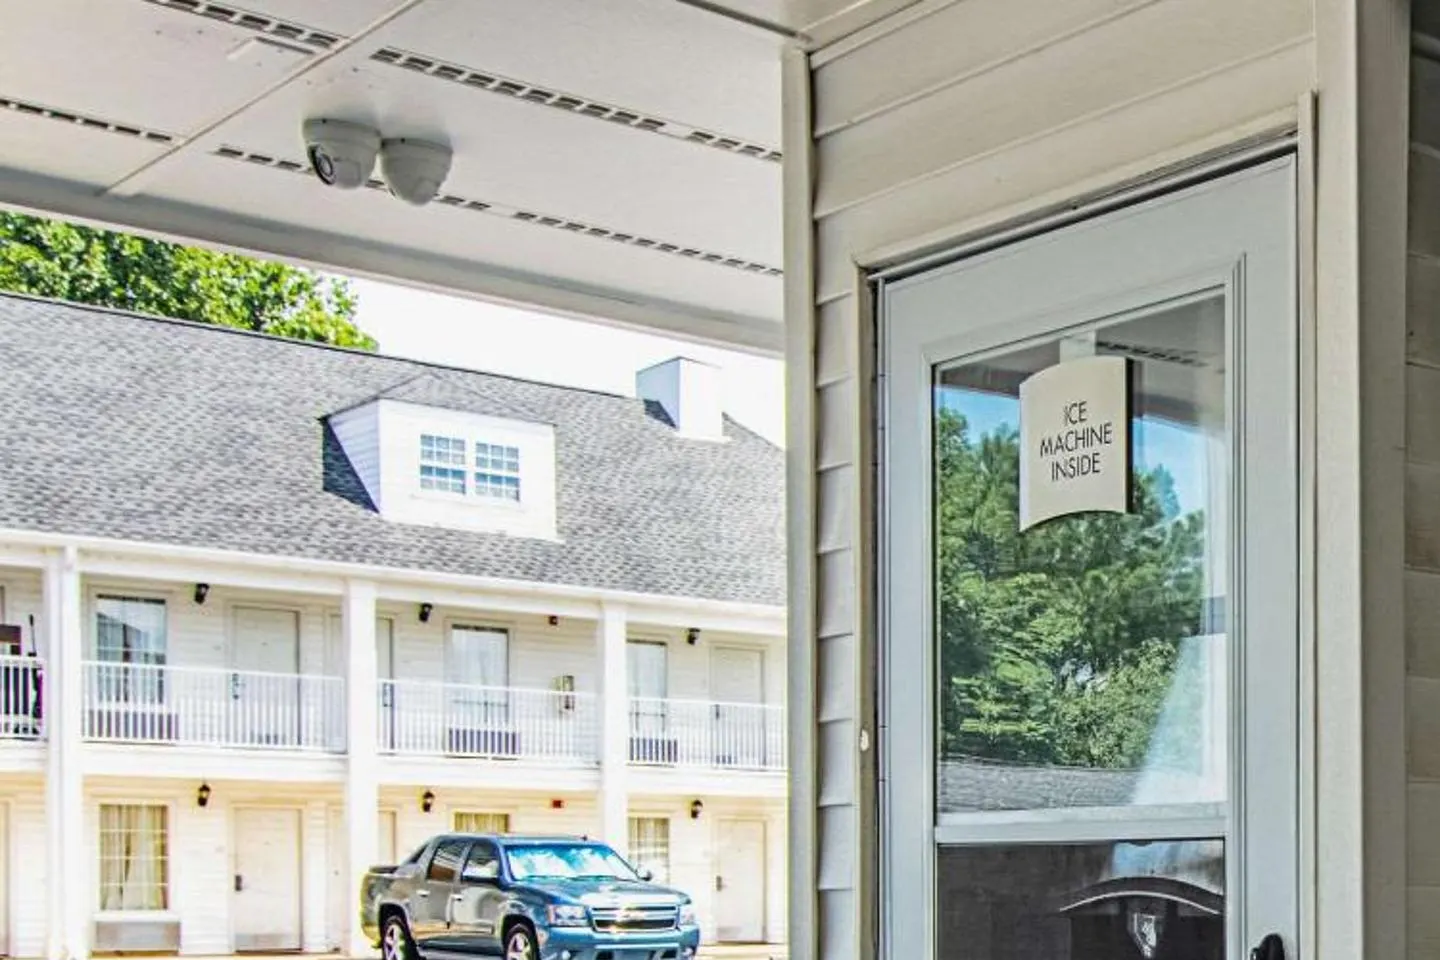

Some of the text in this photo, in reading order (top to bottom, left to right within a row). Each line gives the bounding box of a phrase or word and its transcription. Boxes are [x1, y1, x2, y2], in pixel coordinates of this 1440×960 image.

[1063, 401, 1088, 426] ICE
[1040, 422, 1113, 457] MACHINE
[1051, 453, 1100, 481] INSIDE
